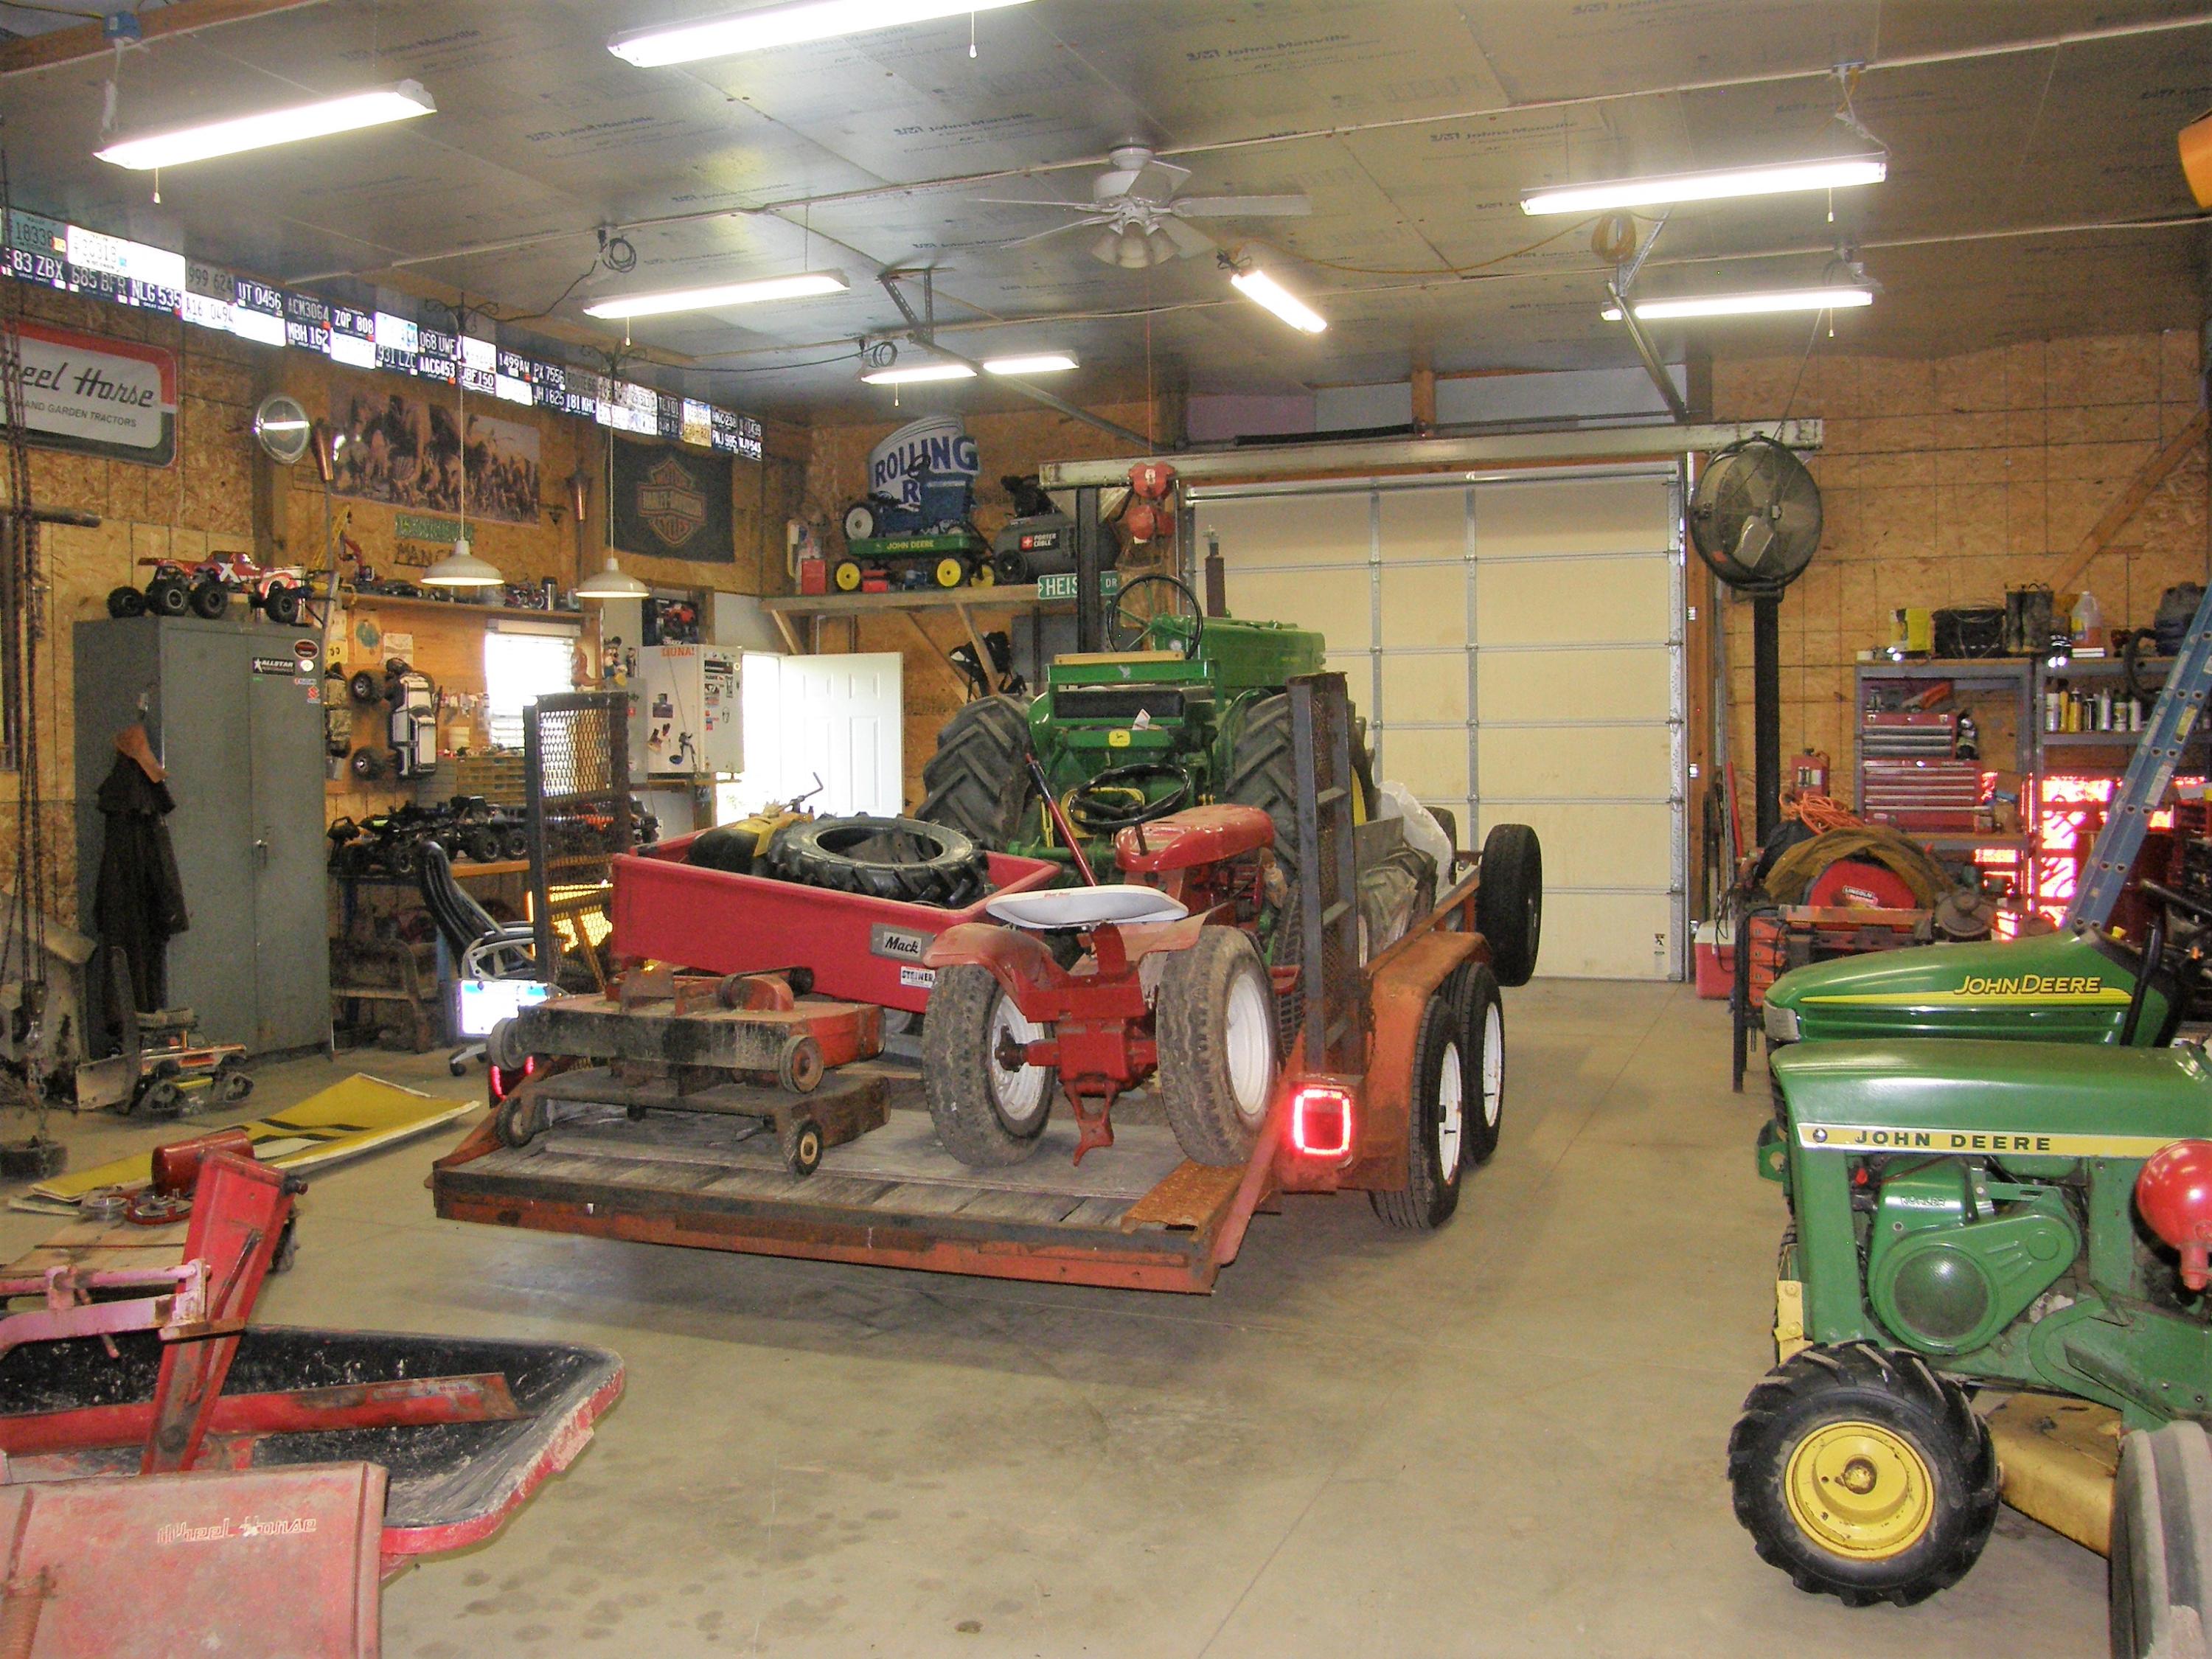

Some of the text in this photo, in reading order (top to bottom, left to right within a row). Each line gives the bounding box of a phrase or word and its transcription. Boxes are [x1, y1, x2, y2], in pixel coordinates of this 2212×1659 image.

[35, 254, 63, 280] ZBX
[188, 266, 209, 287] 999
[72, 265, 126, 295] 685 BFR
[132, 279, 182, 310] NLG 535
[238, 282, 251, 302] UT
[254, 287, 281, 310] 0456
[310, 326, 329, 347] 162
[378, 344, 394, 365] 931
[74, 367, 155, 408] Horse
[566, 393, 580, 410] 181
[47, 403, 88, 420] GARDEN
[90, 411, 138, 428] TRACTORS
[874, 435, 979, 488] ROLLING
[886, 540, 935, 551] JOHN DEERE
[1105, 578, 1118, 588] DR
[261, 659, 294, 668] ALLSTAR
[885, 936, 919, 954] Mack
[1953, 973, 2101, 995] JOHN DEERE
[1854, 1130, 2051, 1151] JOHN DEERE
[157, 1517, 235, 1544] Wheel
